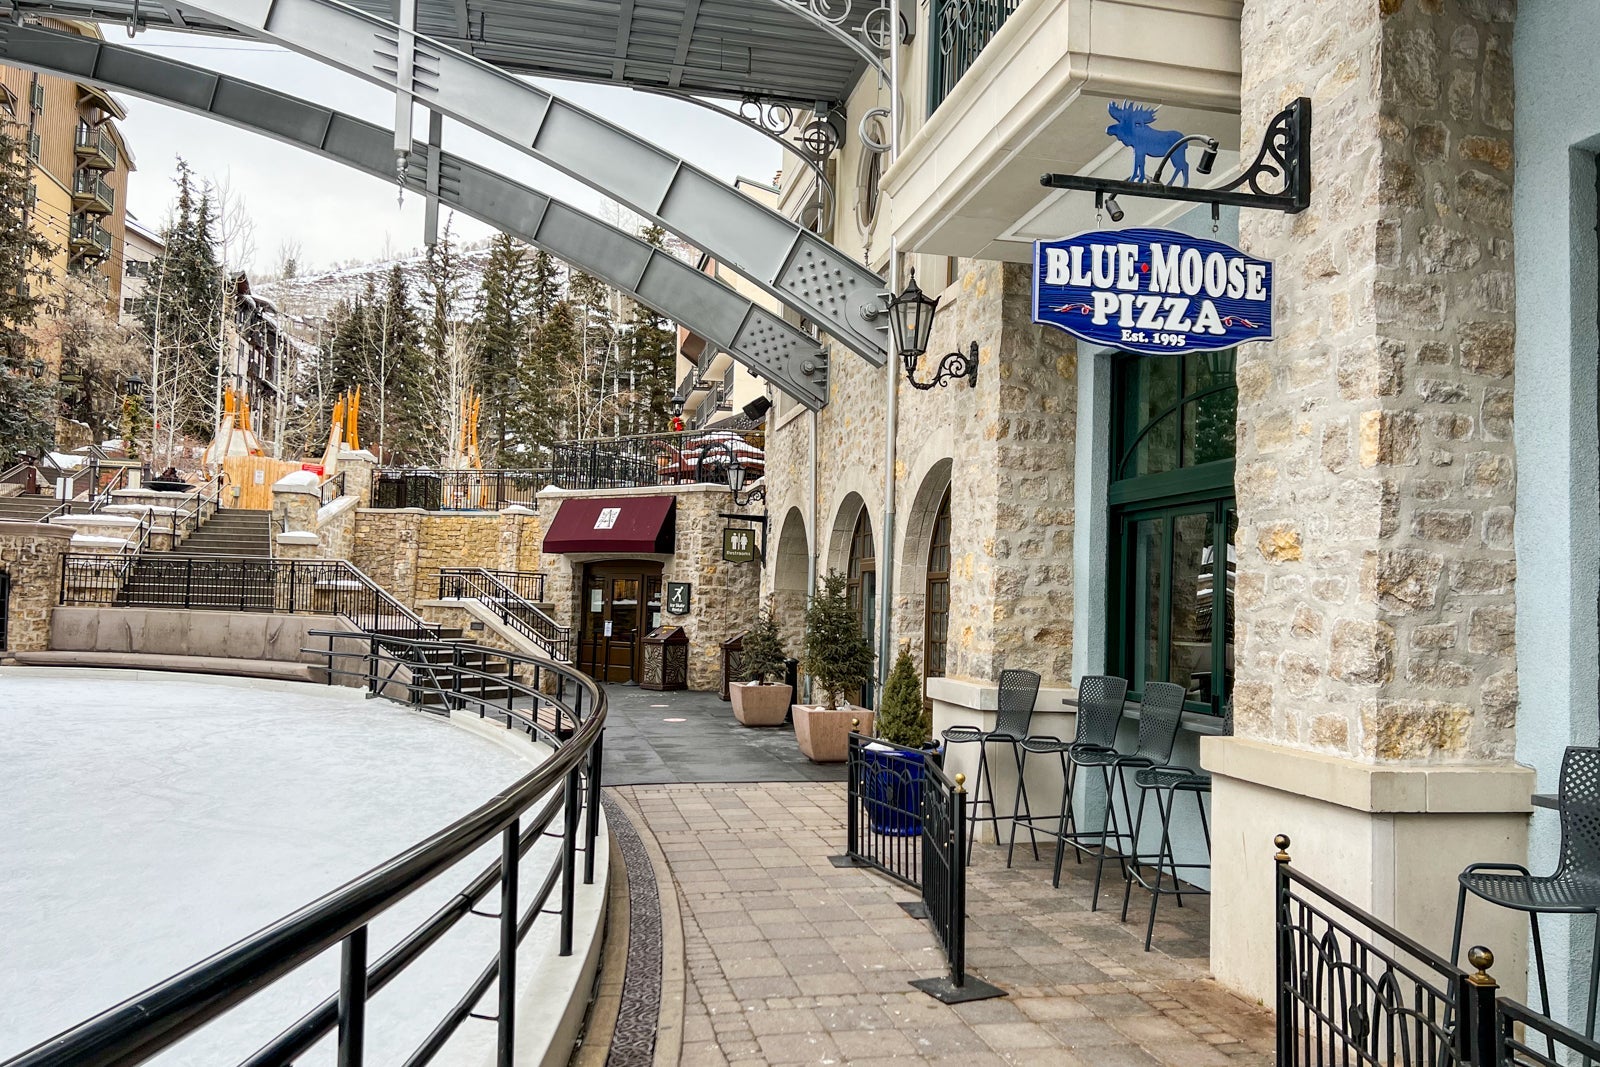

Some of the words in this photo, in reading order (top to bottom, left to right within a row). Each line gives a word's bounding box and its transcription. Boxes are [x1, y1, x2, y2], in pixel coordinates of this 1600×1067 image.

[1045, 243, 1139, 291] BLUE
[1149, 242, 1267, 301] MOOSE
[1091, 291, 1226, 335] PIZZA
[1121, 329, 1149, 343] Est.
[1152, 332, 1186, 347] 1995
